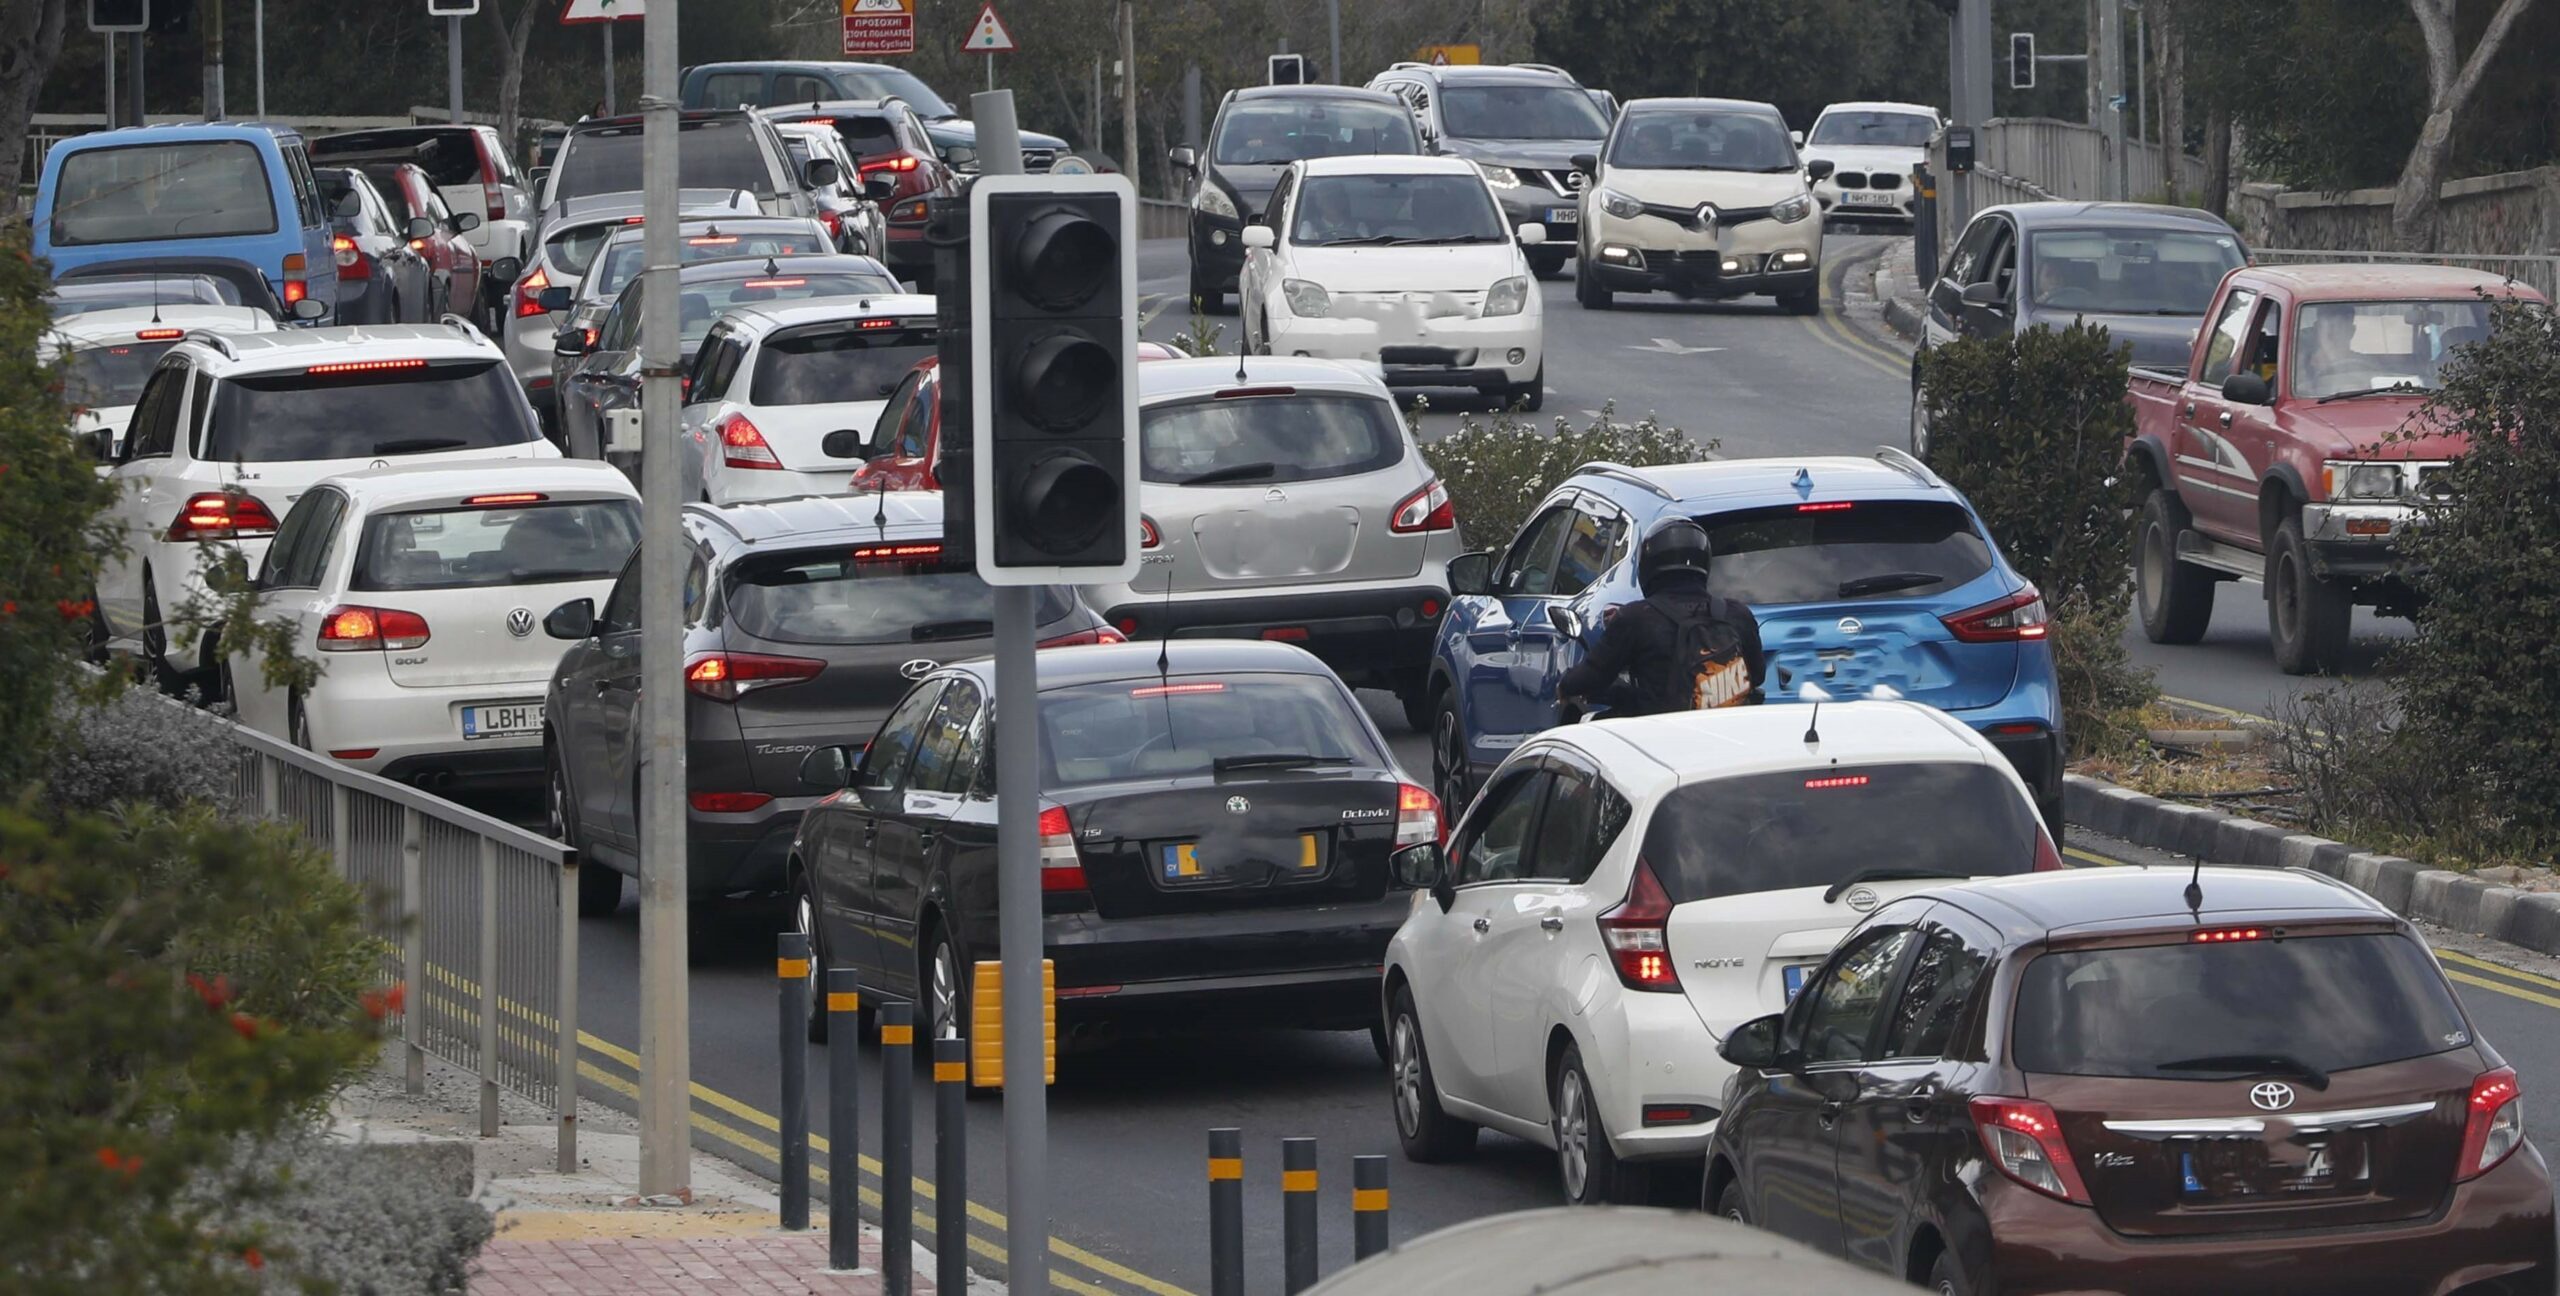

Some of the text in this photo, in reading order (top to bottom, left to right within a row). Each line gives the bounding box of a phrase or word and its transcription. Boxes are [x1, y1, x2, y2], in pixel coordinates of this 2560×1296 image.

[855, 18, 902, 27] ΠΡΟΣΟΧΗ!
[867, 40, 879, 48] the
[880, 40, 911, 49] Cyclists
[395, 656, 429, 665] GOLF
[1700, 656, 1751, 709] NIKE
[485, 707, 527, 730] LBH
[1342, 808, 1390, 819] Octavia
[1166, 863, 1177, 872] CY
[1694, 957, 1745, 969] NOTE
